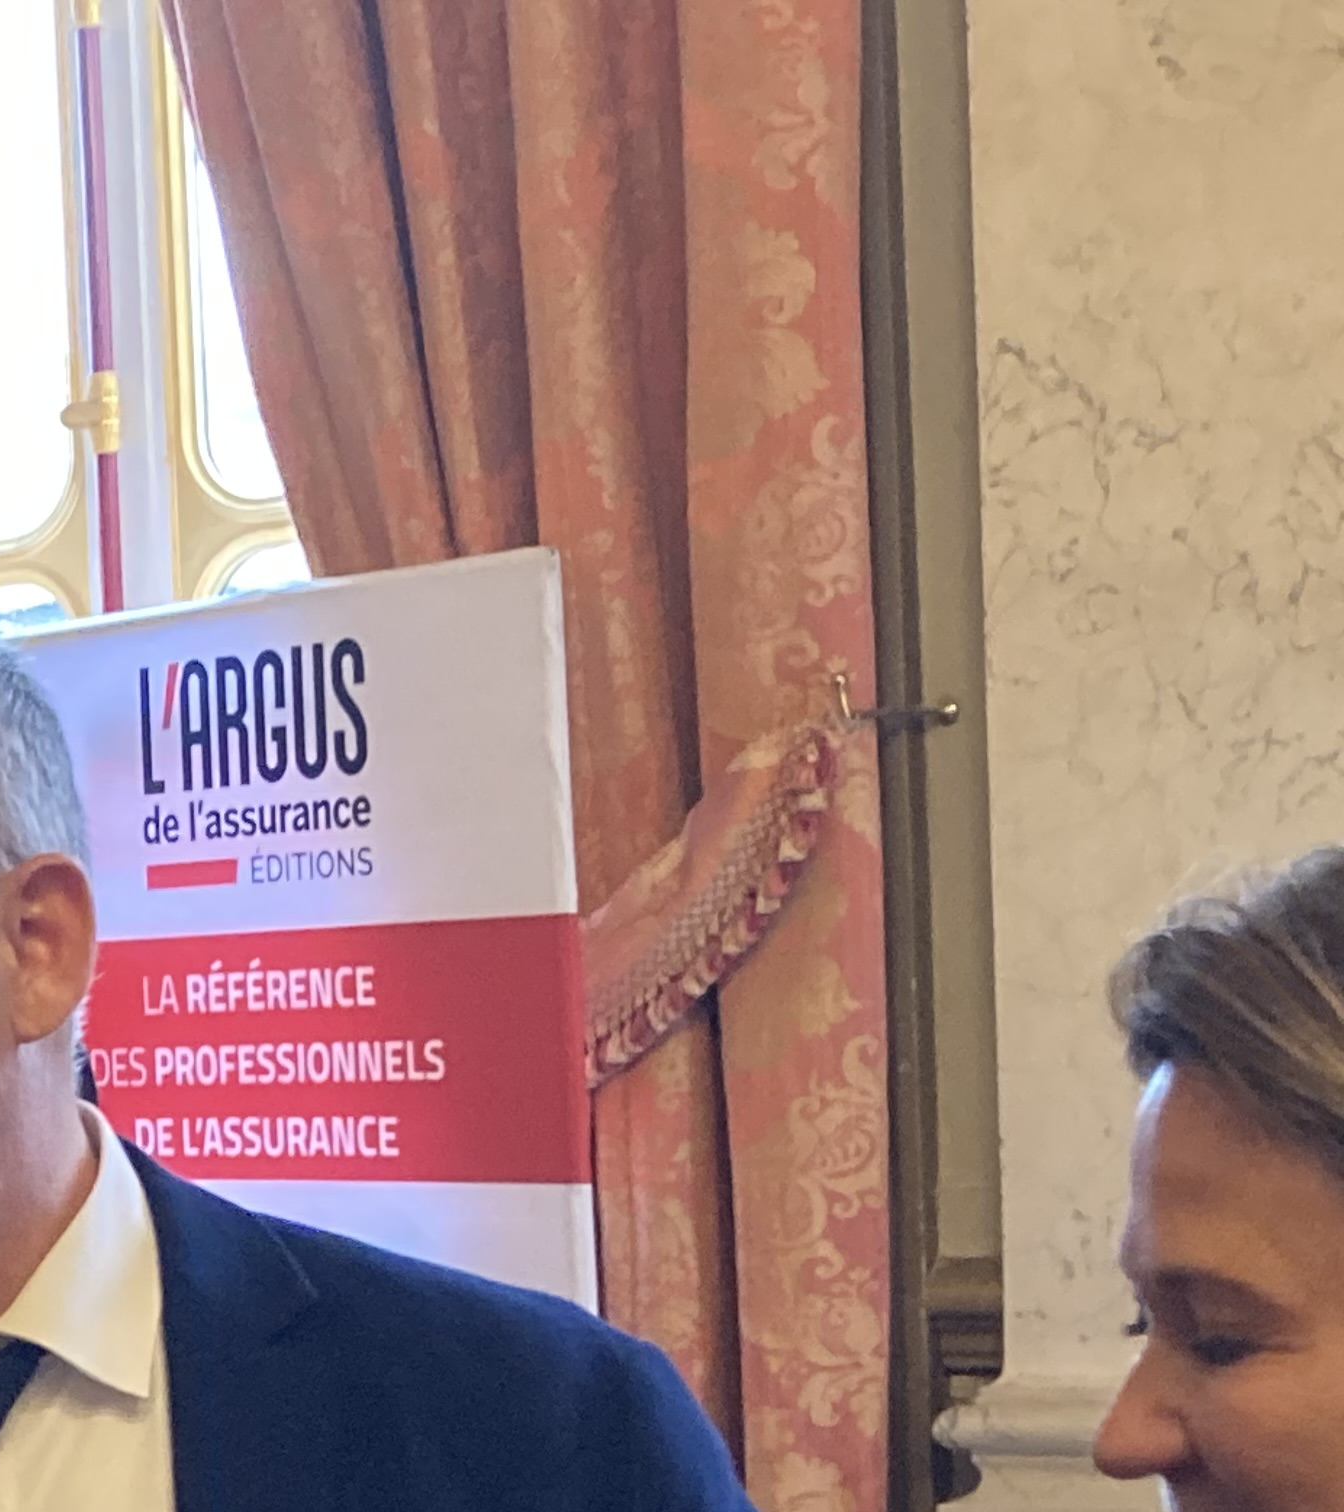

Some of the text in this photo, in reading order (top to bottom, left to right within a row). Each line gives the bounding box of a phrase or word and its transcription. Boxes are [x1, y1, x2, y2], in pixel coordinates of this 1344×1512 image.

[139, 637, 368, 795] L'ARGUS
[143, 794, 372, 845] de l'assurance
[250, 846, 374, 885] ÉDITIONS
[142, 957, 377, 1016] LA RÉFÉRENCE
[91, 1038, 446, 1087] DES PROFESSIONNELS
[134, 1115, 400, 1158] DE L'ASSURANCE
